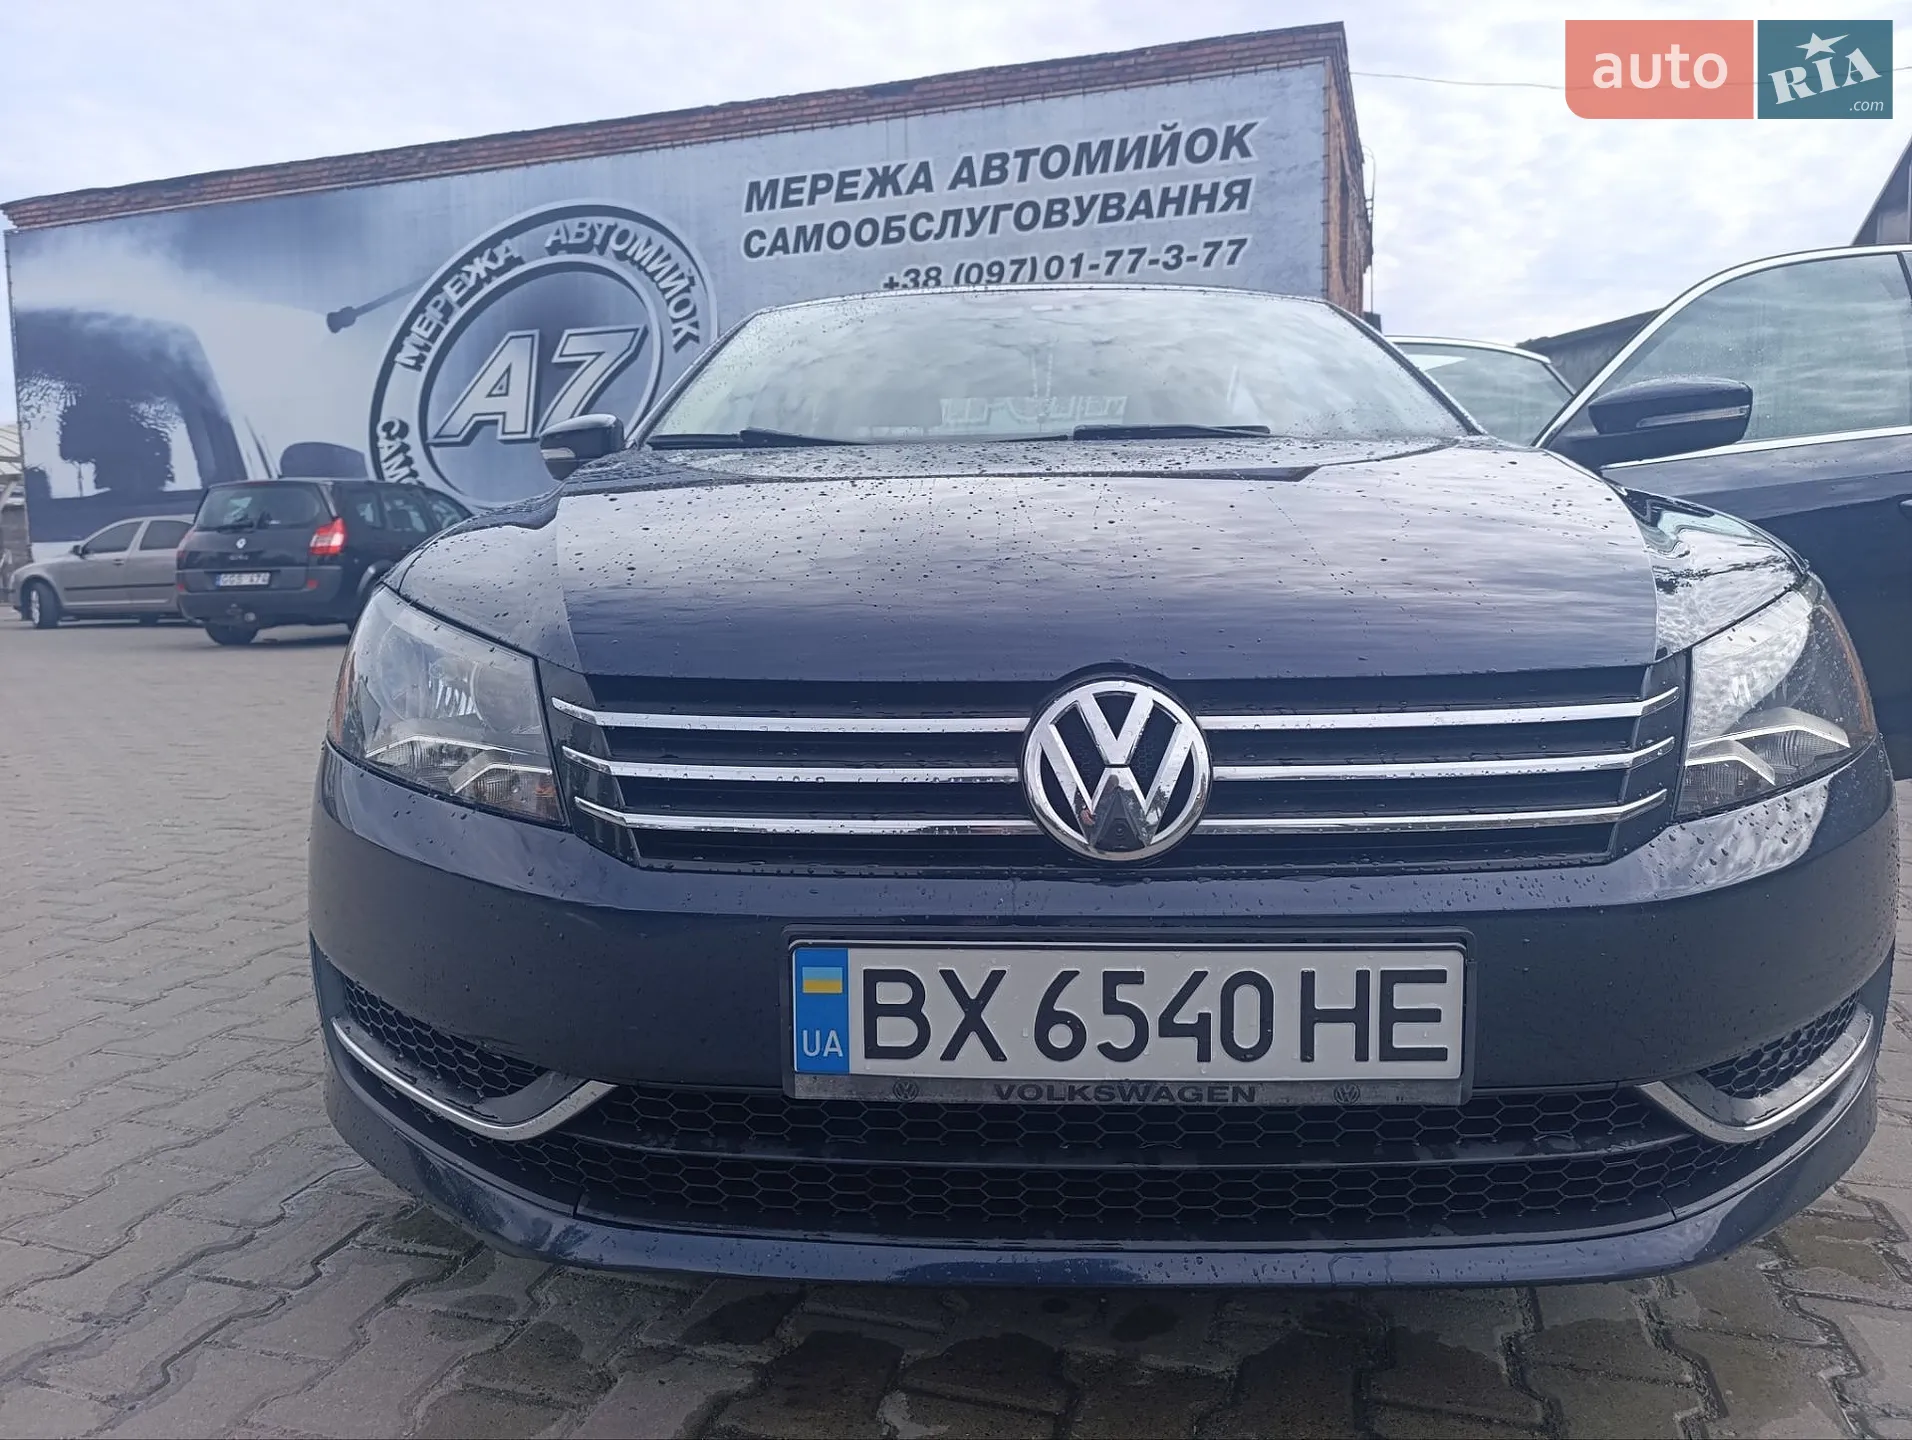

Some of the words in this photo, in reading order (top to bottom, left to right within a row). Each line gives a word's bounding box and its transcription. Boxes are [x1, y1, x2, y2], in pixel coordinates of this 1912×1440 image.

[744, 160, 934, 213] МЕРЕЖА
[948, 121, 1260, 191] АВТОМИЙОК
[743, 178, 1252, 259] САМООБСЛУГОВУВАННЯ
[394, 238, 528, 372] МЕРЕЖА
[544, 220, 701, 353] АВТОМИЙОК
[883, 266, 942, 289] +38
[376, 419, 418, 484] САМ
[802, 1029, 844, 1059] UA
[862, 968, 1007, 1062] BX
[1034, 969, 1276, 1063] 6540
[1301, 969, 1449, 1062] HE
[994, 1083, 1256, 1104] VOLKSWAGEN
